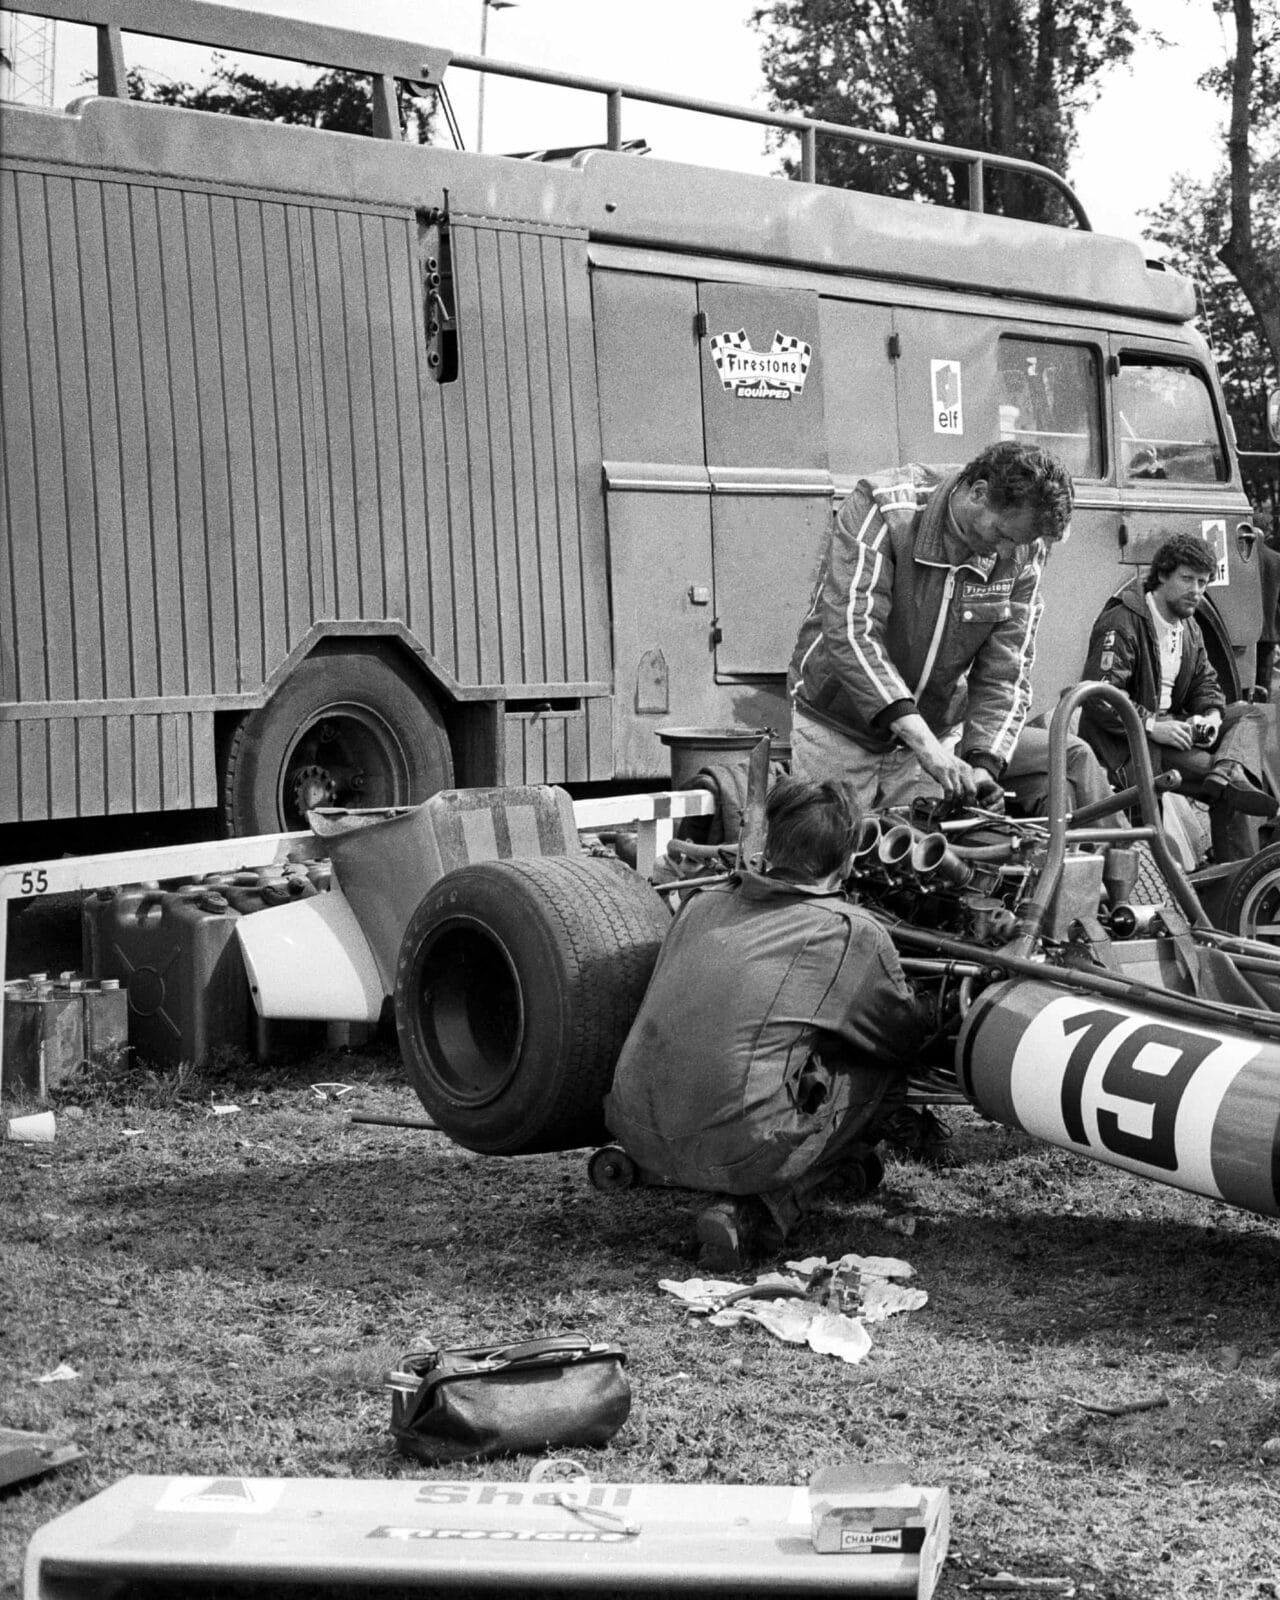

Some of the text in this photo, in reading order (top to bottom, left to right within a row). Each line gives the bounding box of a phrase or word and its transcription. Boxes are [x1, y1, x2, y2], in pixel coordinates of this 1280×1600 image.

[726, 353, 797, 374] Firestone
[737, 387, 790, 399] EQUIPPED
[938, 410, 959, 429] elf
[20, 869, 49, 895] 55
[1060, 1008, 1224, 1172] 19
[414, 1484, 633, 1508] Shell
[844, 1534, 899, 1544] CHAMPION
